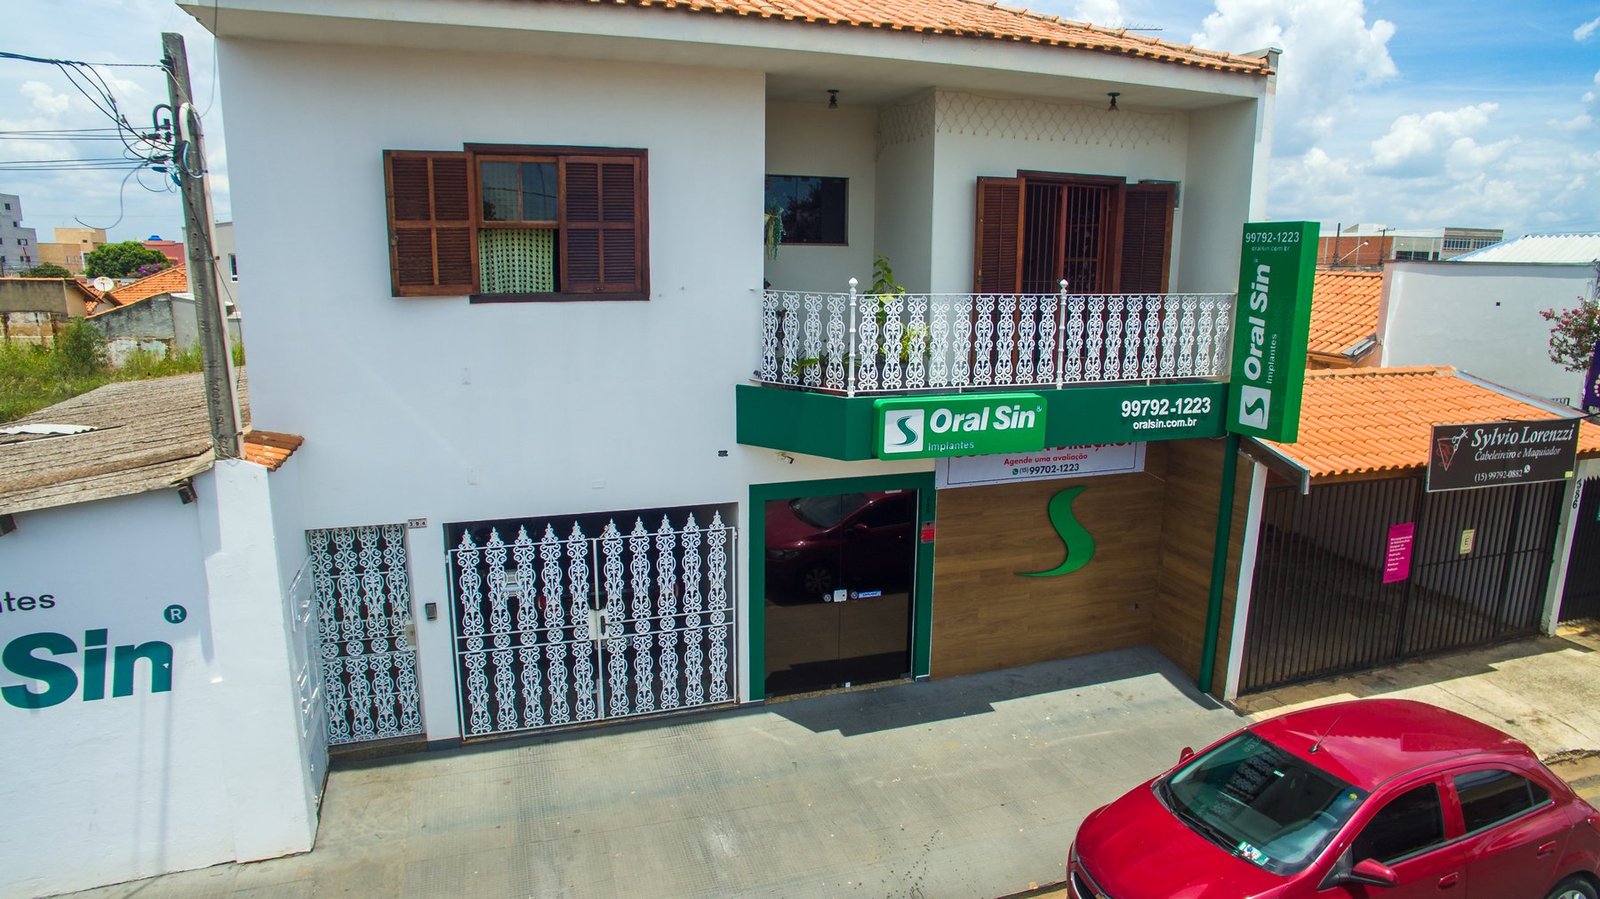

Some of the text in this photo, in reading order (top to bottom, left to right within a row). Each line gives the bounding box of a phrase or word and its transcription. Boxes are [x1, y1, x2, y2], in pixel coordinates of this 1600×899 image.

[1245, 231, 1300, 243] 99792-1223
[1243, 264, 1271, 381] Oral Sin
[1266, 333, 1278, 384] Implantes
[1121, 397, 1211, 418] 99792-1223
[929, 404, 1036, 434] Oral Sin
[1132, 417, 1198, 430] oralsin.com.br
[928, 440, 975, 452] Implantes
[1470, 423, 1575, 451] Sylvio Lorenzzi
[1003, 456, 1033, 467] Agende
[1034, 456, 1051, 464] uma
[1052, 452, 1088, 464] avaliação
[1474, 449, 1516, 461] Cabeleireiro
[1522, 445, 1561, 459] Maquiador
[1029, 463, 1080, 475] 99702-1223
[1474, 473, 1487, 483] (15)
[0, 591, 56, 614] tes
[0, 627, 174, 710] Sin
